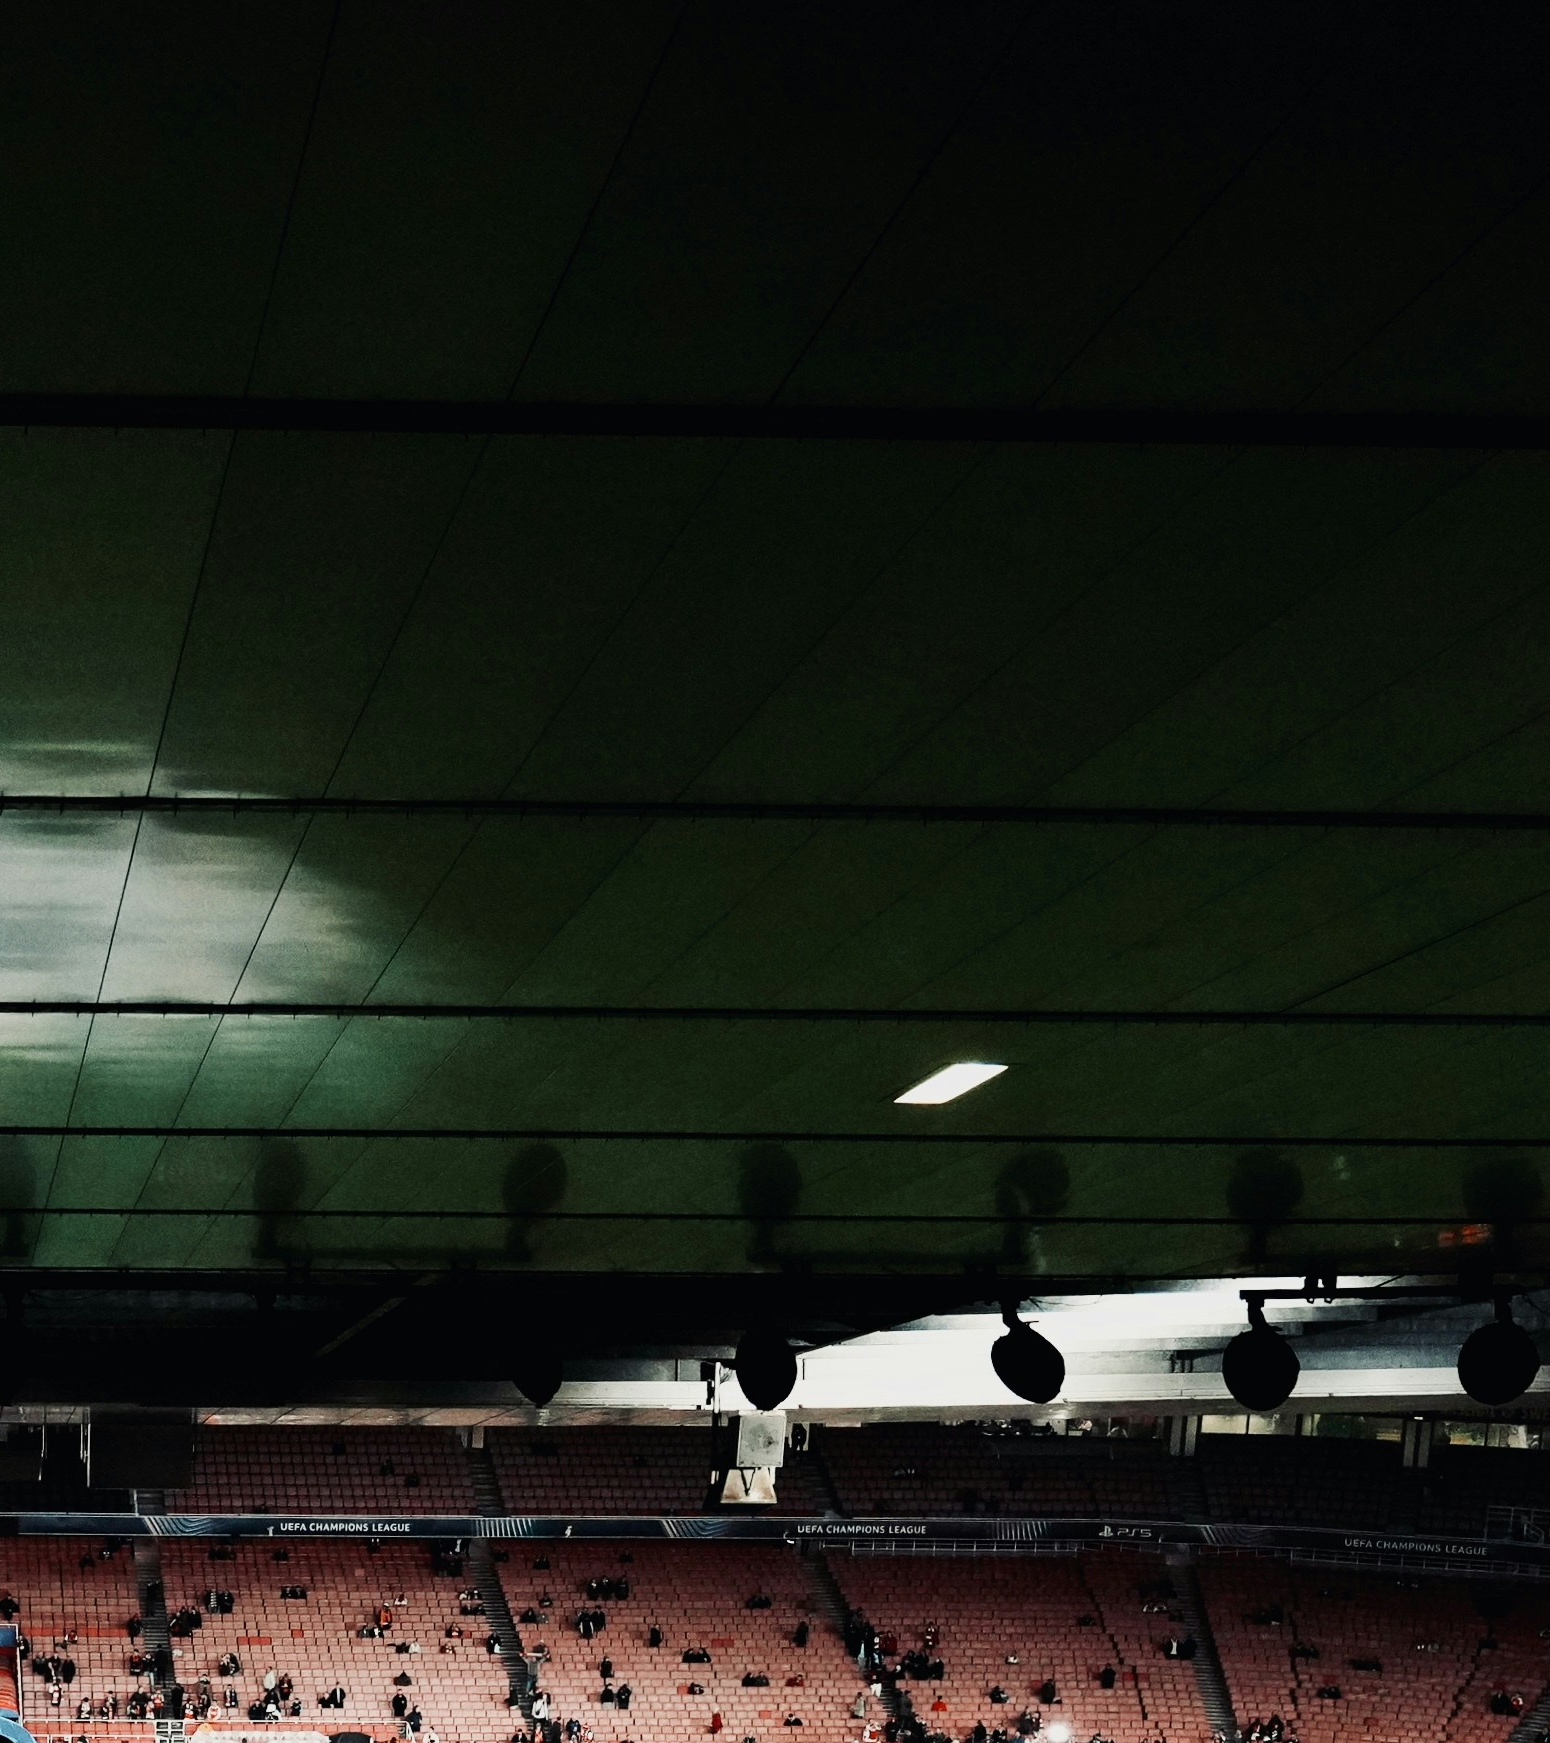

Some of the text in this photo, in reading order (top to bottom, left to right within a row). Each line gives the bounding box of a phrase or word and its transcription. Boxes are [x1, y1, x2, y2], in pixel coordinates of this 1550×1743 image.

[280, 1522, 411, 1532] UEFA CHAMPIONS LEAGUE
[797, 1525, 927, 1535] UEFA CHAMPIONS LEAGUE
[1344, 1538, 1488, 1556] UEFA CHAMPIONS LEAGUE
